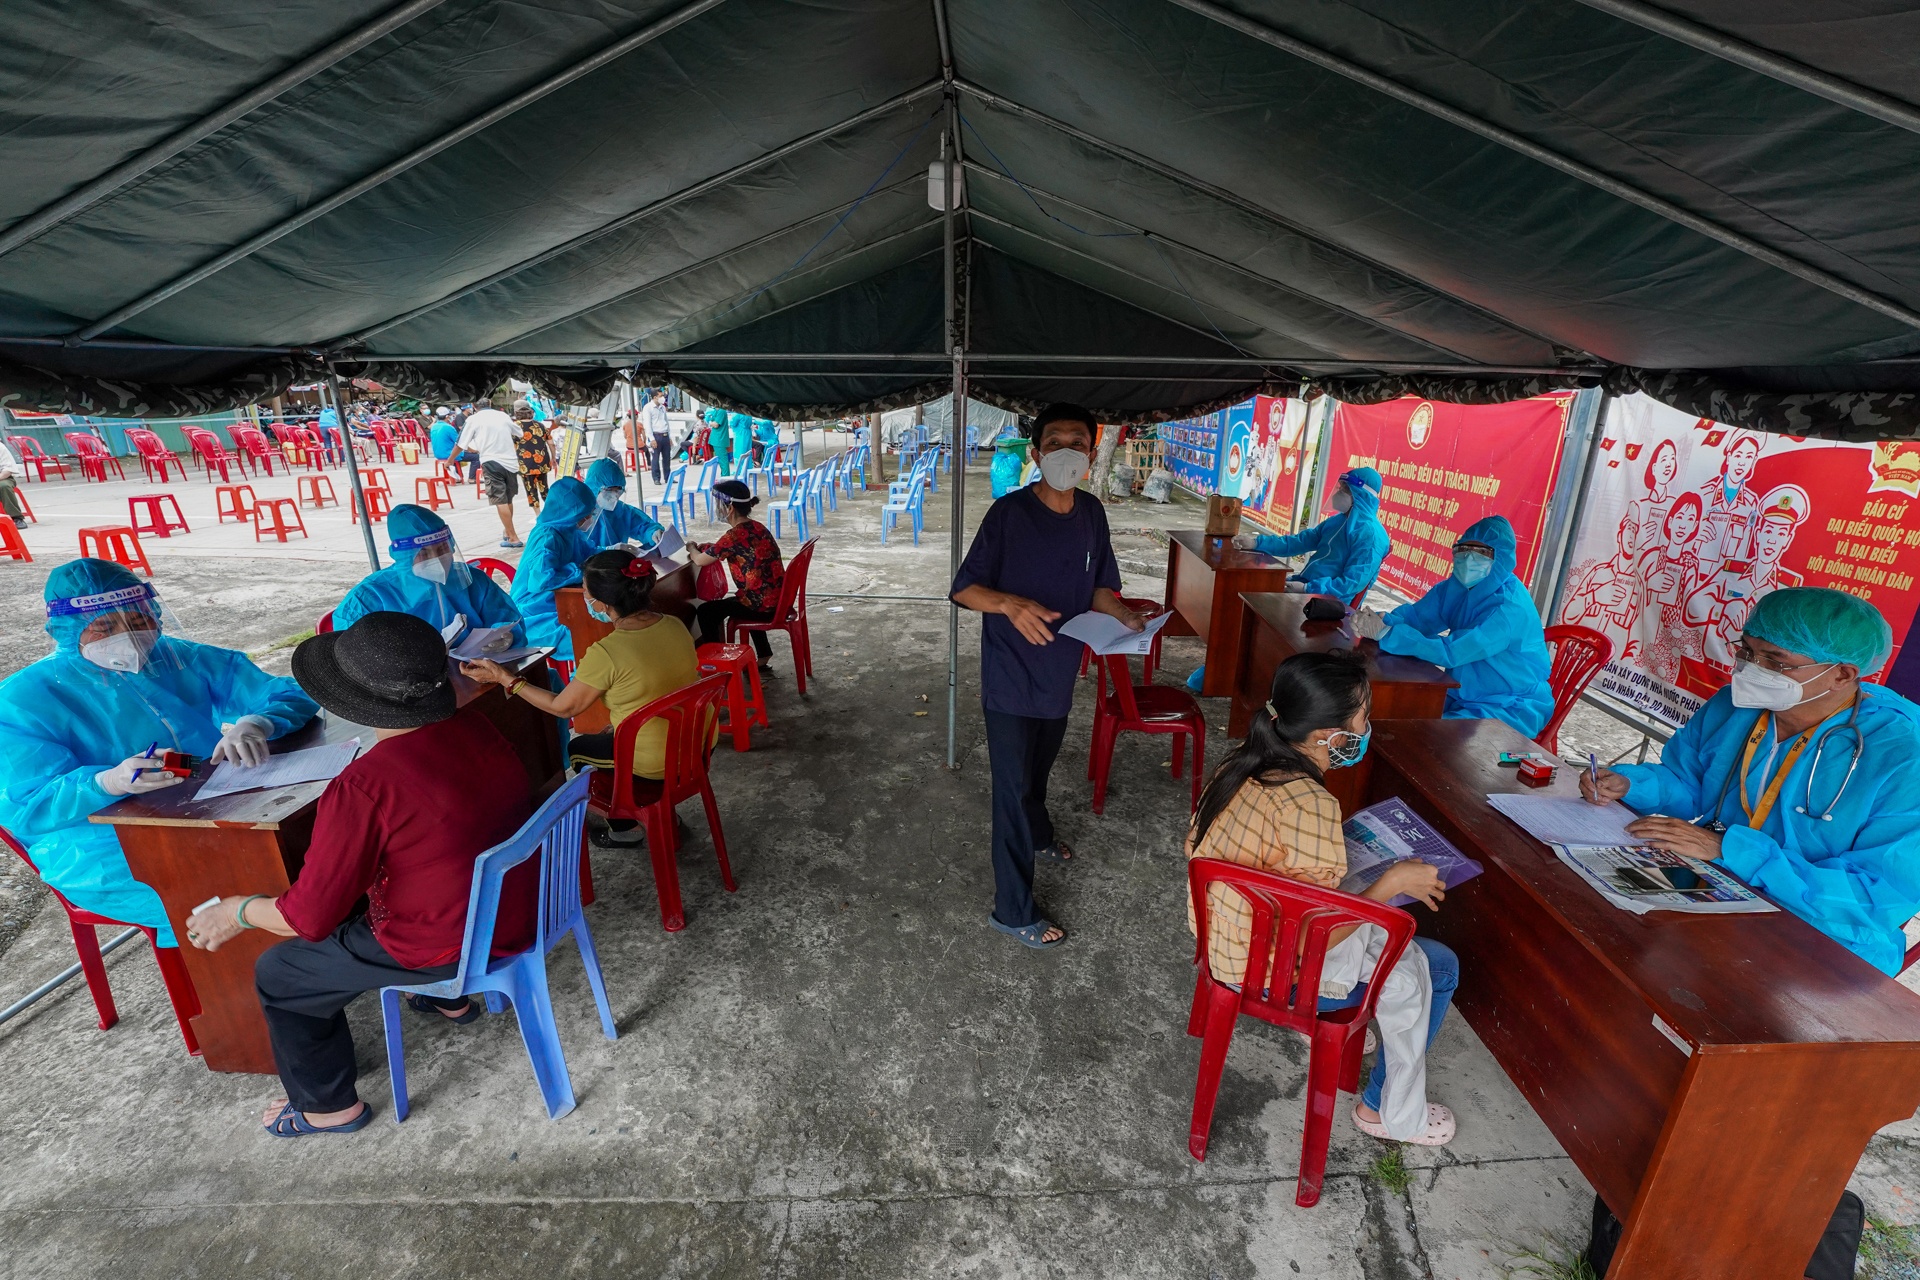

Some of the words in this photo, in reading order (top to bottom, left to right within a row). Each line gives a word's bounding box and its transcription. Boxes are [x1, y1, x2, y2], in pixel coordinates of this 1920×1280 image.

[1378, 459, 1390, 478] MỌI
[1399, 461, 1417, 480] CHỨC
[1432, 466, 1444, 486] CÓ
[1444, 469, 1470, 492] TRÁCH
[1470, 472, 1501, 500] NHIỆM
[1381, 485, 1391, 503] VỤ
[1390, 487, 1412, 506] TRONG
[1411, 490, 1428, 512] VIỆC
[1427, 496, 1444, 517] HỌC
[1443, 498, 1460, 521] TẬP
[1861, 498, 1888, 519] BẦU
[1886, 500, 1909, 520] CỬ
[1386, 511, 1400, 531] CỰC
[1399, 514, 1414, 534] XÂY
[1412, 520, 1433, 541] DỰNG
[1431, 525, 1457, 549] THÀNH
[1826, 518, 1847, 536] ĐẠI
[1844, 517, 1873, 538] BIỂU
[1871, 522, 1905, 543] QUỐC
[1903, 529, 1920, 550] HỘ
[1409, 546, 1426, 569] MỘT
[1423, 553, 1449, 577] THÀNH
[1835, 539, 1850, 556] VÀ
[1849, 543, 1871, 562] ĐẠI
[1868, 544, 1899, 565] BIỂU
[1806, 555, 1826, 574] HỘI
[1824, 557, 1854, 579] ĐỒNG
[1853, 566, 1887, 586] NHÂN
[1885, 571, 1914, 591] DÂN
[76, 597, 105, 606] Face
[1849, 584, 1872, 601] CẤP
[1602, 674, 1615, 692] CỦA
[1616, 683, 1636, 700] NHÂN
[1649, 699, 1663, 712] DO
[1660, 704, 1681, 723] NHÂN
[1618, 667, 1633, 681] XÂY
[1630, 671, 1651, 689] DỰNG
[1649, 680, 1663, 696] NHÀ
[1662, 687, 1680, 704] NƯỚC
[1680, 695, 1701, 713] PHÁP
[1398, 826, 1426, 842] My
